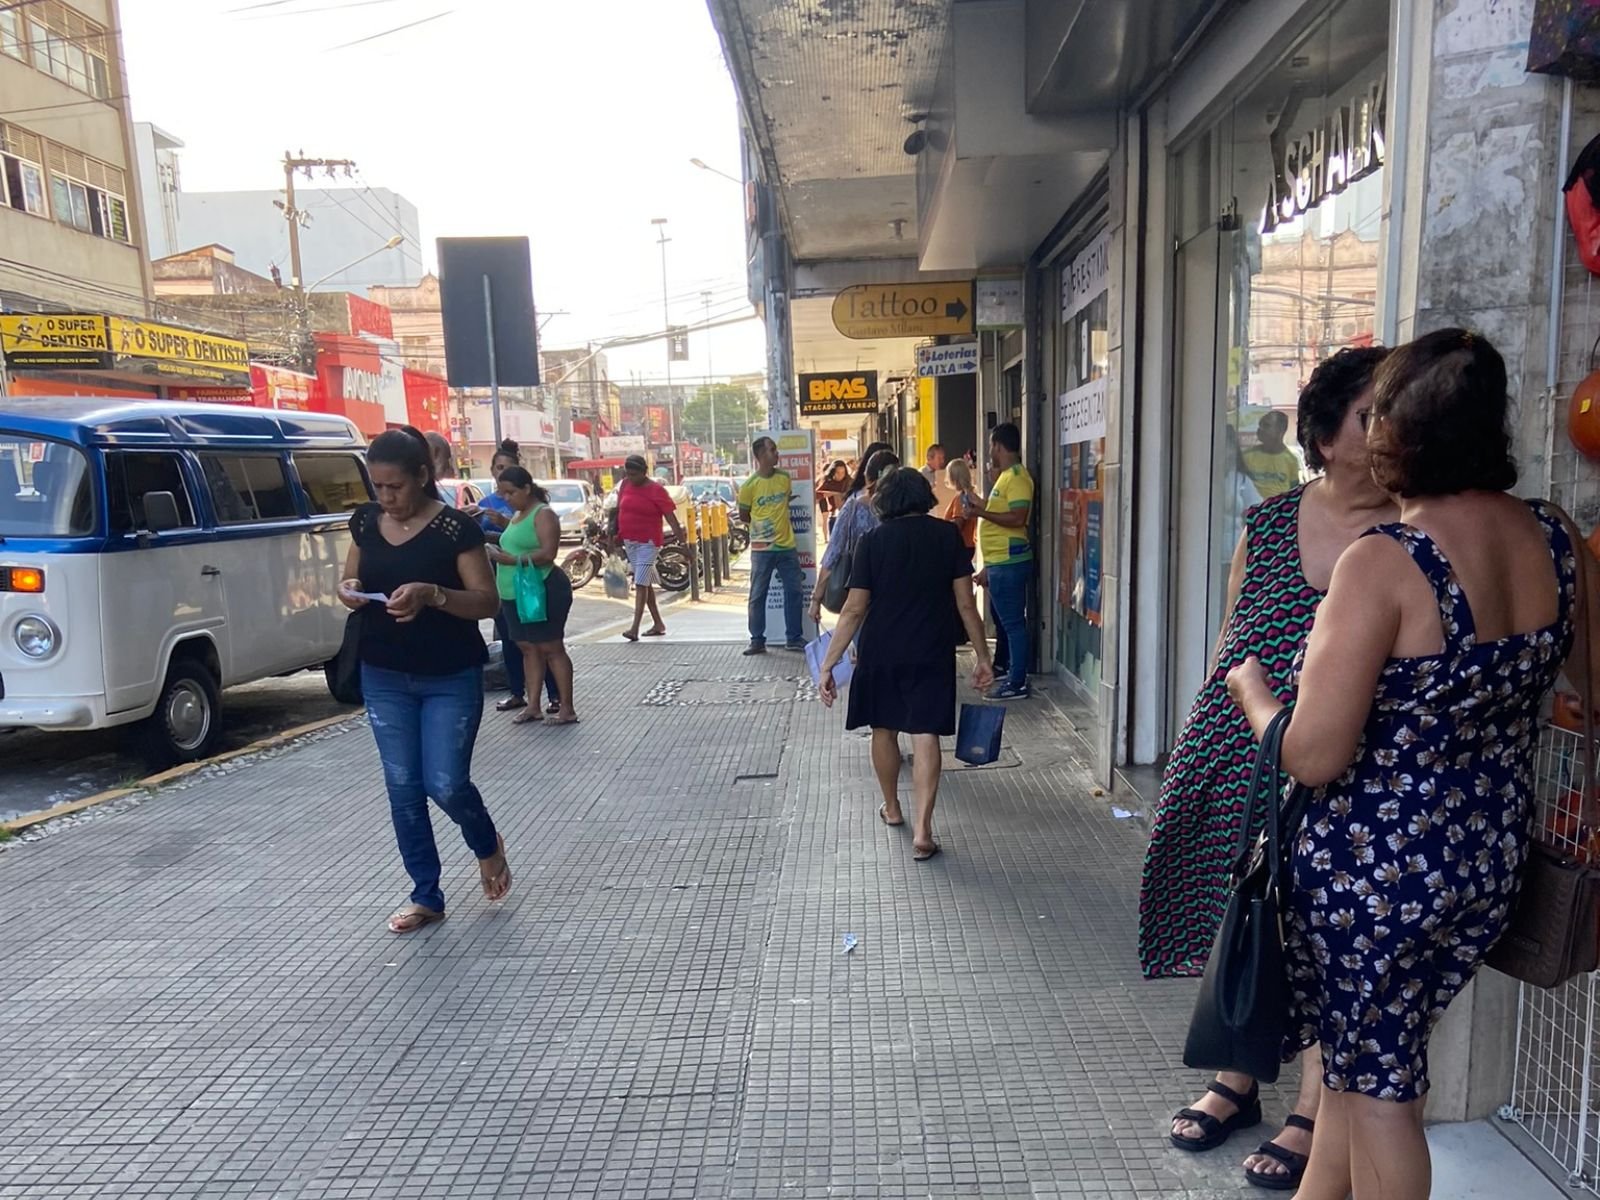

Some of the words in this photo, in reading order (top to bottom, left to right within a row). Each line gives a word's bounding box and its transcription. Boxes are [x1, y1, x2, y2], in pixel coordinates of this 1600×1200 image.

[842, 291, 938, 318] Tattoo
[47, 319, 55, 331] O
[58, 319, 96, 331] SUPER
[41, 334, 105, 348] DENTISTA
[135, 327, 145, 349] O
[148, 330, 191, 357] SUPER
[193, 338, 249, 367] DENTISTA
[932, 348, 976, 361] Loterias
[919, 363, 956, 376] CAIXA
[809, 377, 868, 401] BRAS
[803, 403, 837, 411] ATACADO
